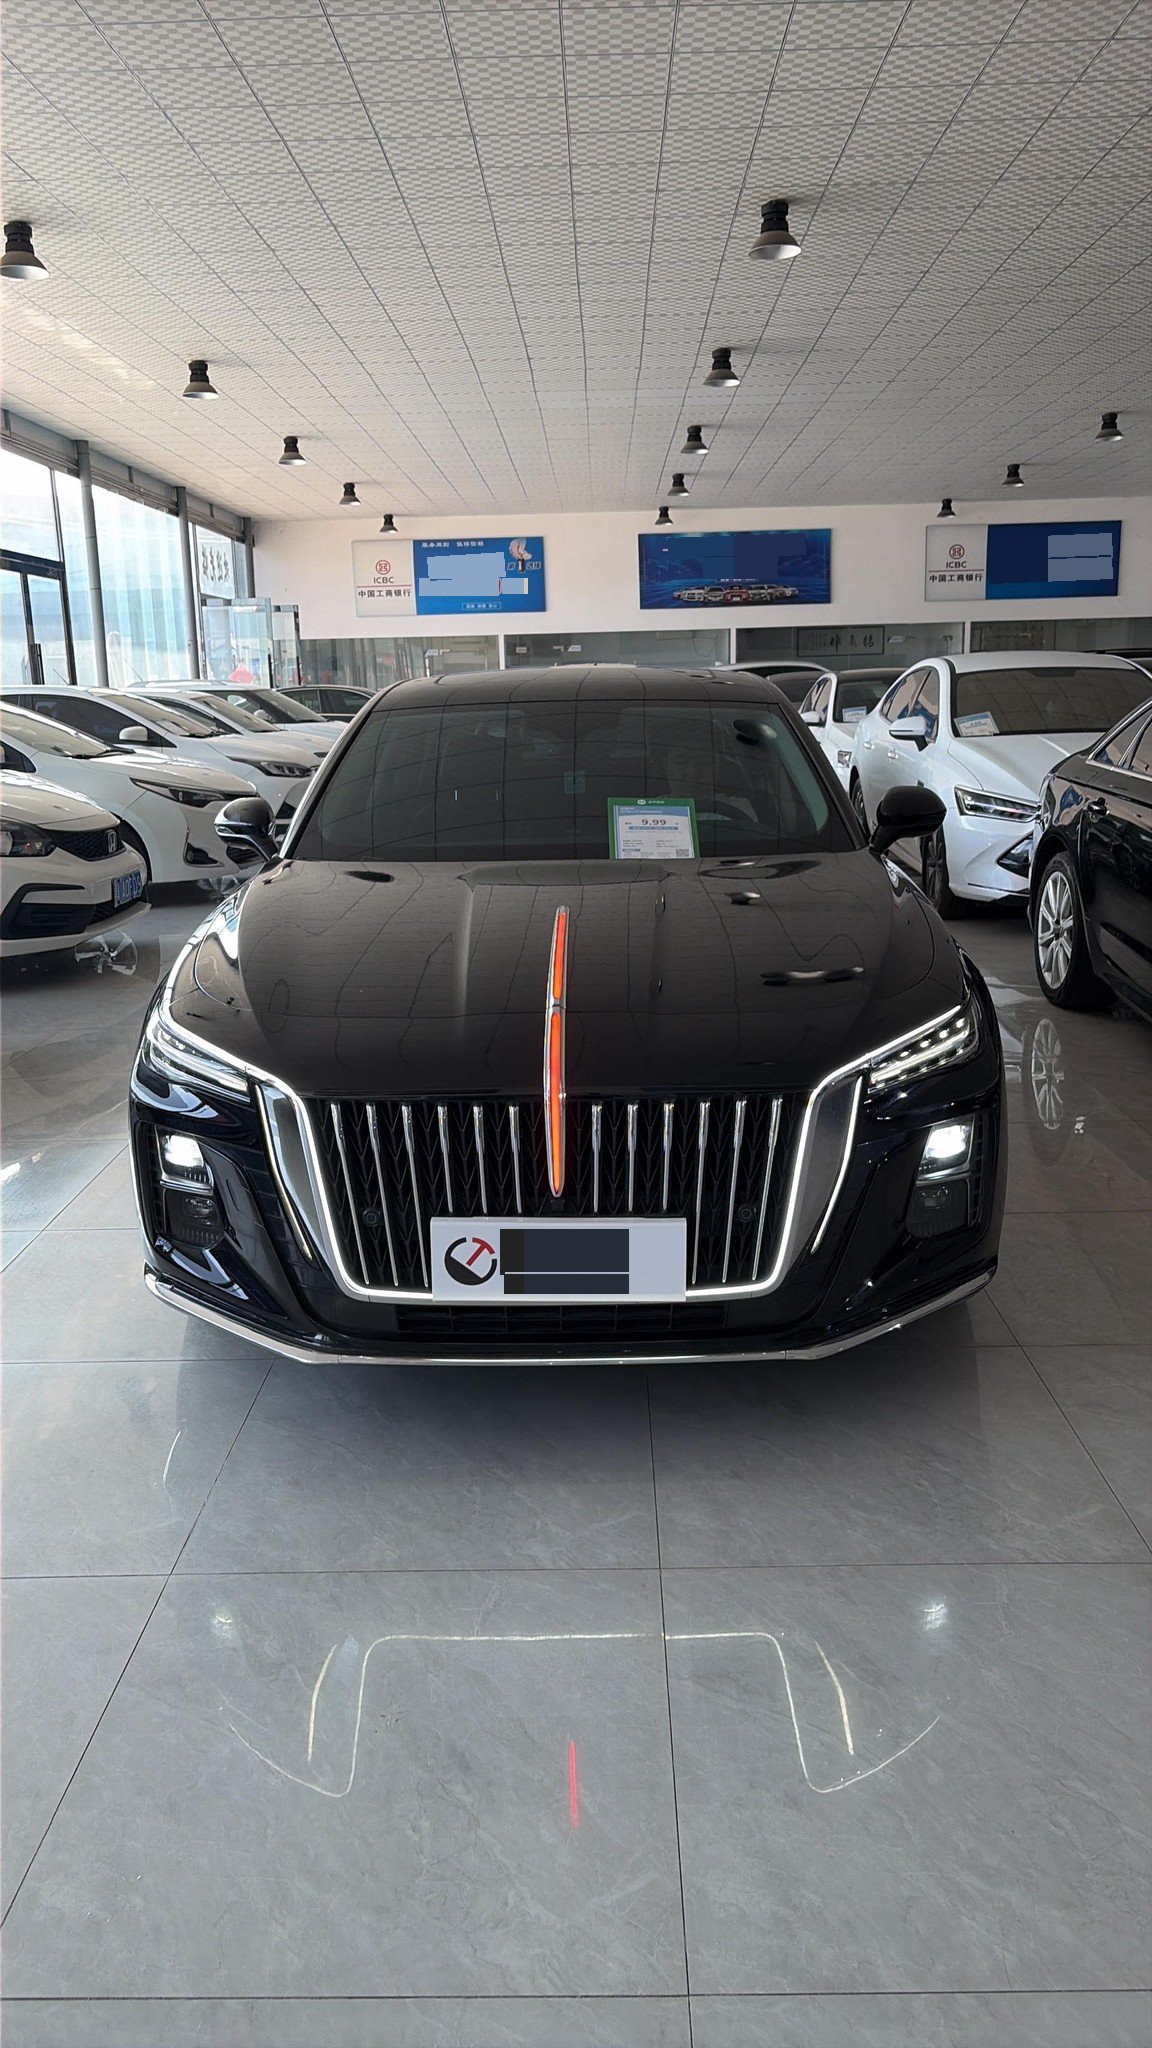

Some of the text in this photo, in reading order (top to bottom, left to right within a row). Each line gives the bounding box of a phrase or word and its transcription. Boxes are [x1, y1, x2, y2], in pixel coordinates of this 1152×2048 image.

[945, 560, 968, 569] ICBC
[373, 576, 394, 584] ICBC
[929, 573, 983, 583] 中国工商银行
[358, 588, 411, 598] 中国工商银行
[641, 818, 667, 826] 9.99
